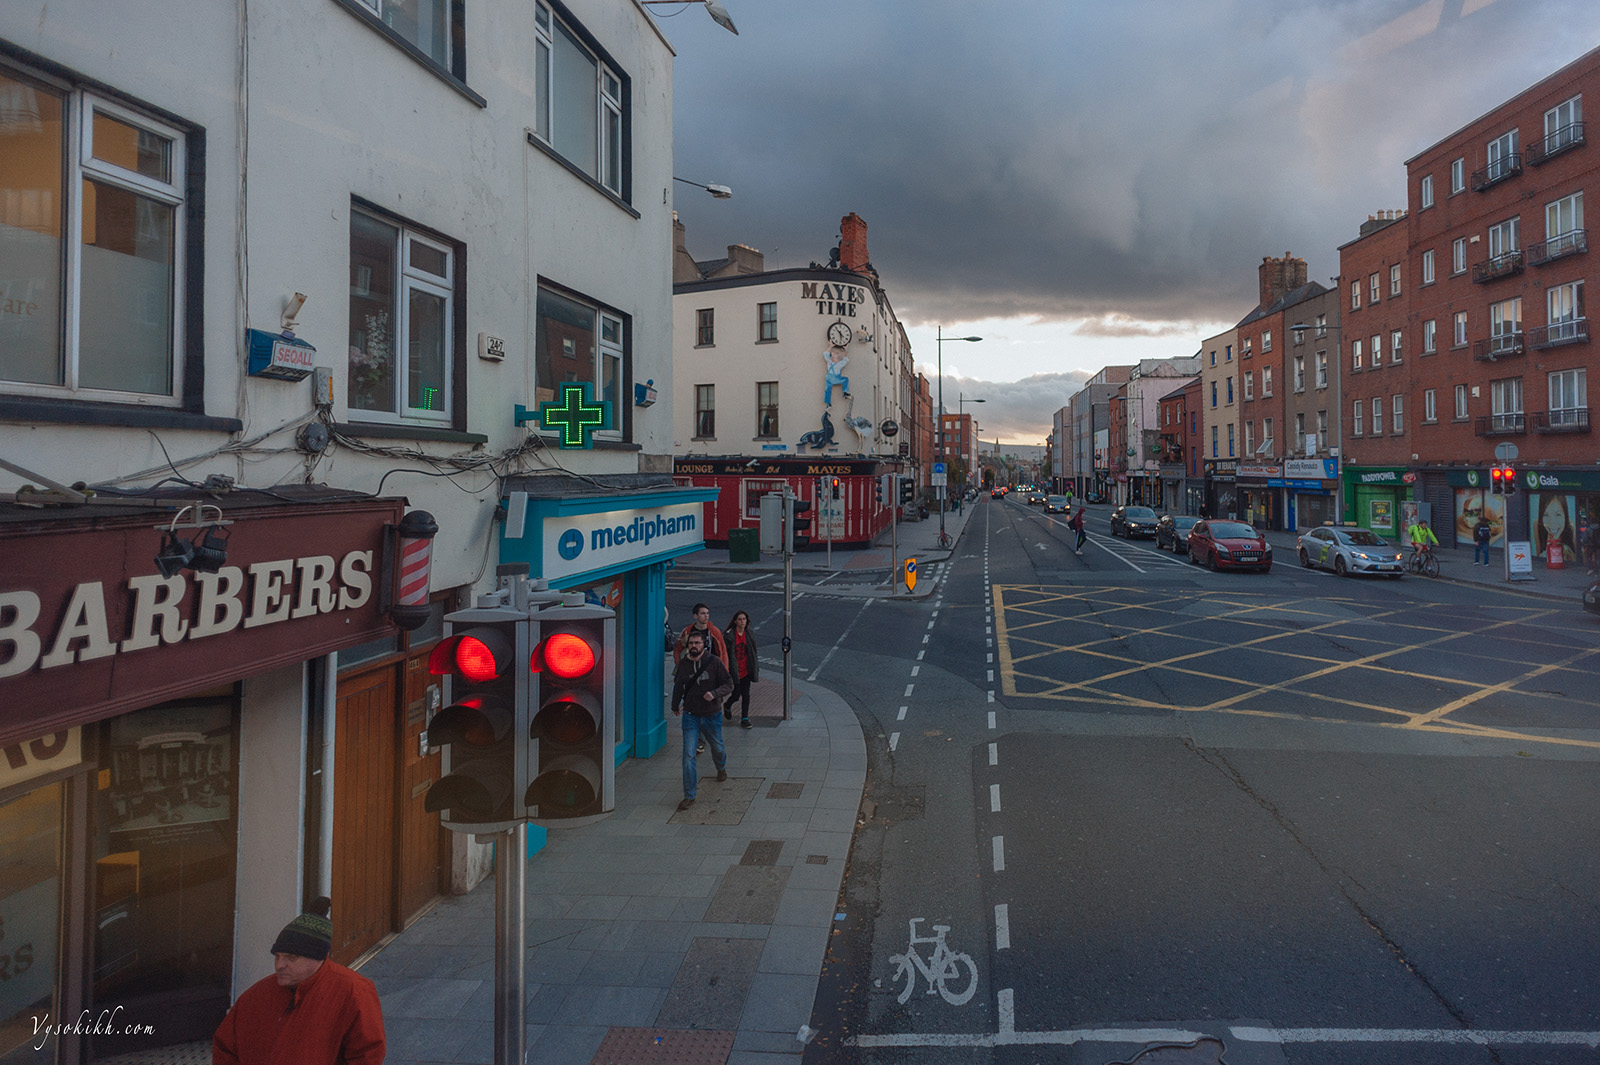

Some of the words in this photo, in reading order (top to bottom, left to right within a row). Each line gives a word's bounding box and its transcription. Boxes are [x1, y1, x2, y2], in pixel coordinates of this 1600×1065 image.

[801, 282, 865, 304] MAYES
[0, 290, 38, 317] are
[816, 300, 857, 317] TIME
[676, 464, 714, 474] LOUNGE
[807, 465, 851, 474] MAYES
[1539, 474, 1559, 486] Gala
[591, 514, 696, 550] medipharm
[0, 550, 374, 678] BARBERS
